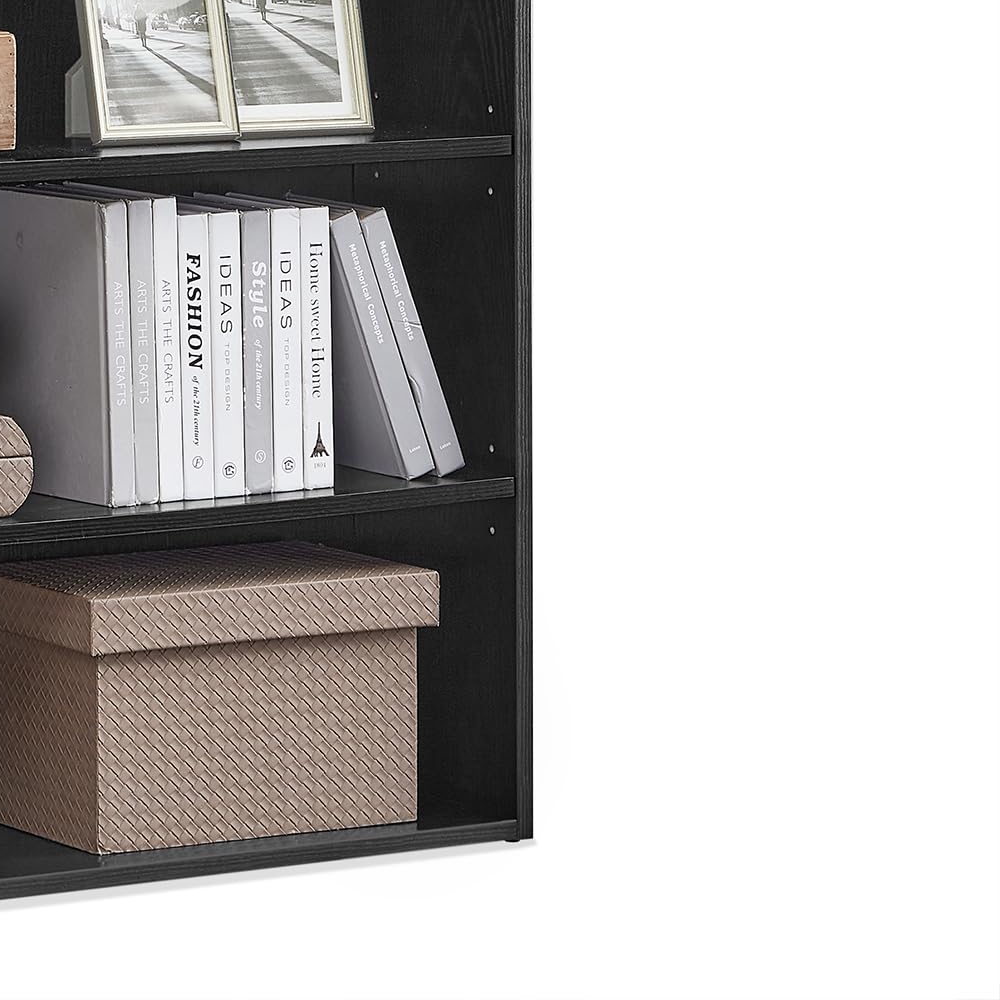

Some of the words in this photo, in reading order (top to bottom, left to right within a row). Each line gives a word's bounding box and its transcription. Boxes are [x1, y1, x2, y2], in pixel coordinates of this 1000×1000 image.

[280, 251, 293, 329] IDEAS
[310, 243, 324, 294] Home
[348, 243, 372, 301] Metaphorical
[368, 303, 384, 344] Concepts
[380, 240, 403, 298] Metaphorical
[398, 300, 415, 341] Concepts
[113, 281, 124, 315] ARTS
[137, 279, 148, 313] ARTS
[162, 279, 172, 313] ARTS
[186, 253, 203, 370] FASHION
[219, 255, 233, 334] IDEAS
[248, 261, 268, 328] Style
[310, 299, 322, 341] sweet
[115, 321, 125, 349] THE
[138, 319, 148, 347] THE
[163, 319, 173, 346] THE
[254, 339, 263, 349] of
[115, 355, 127, 407] CRAFTS
[138, 353, 149, 404] CRAFTS
[163, 353, 174, 404] CRAFTS
[192, 375, 200, 385] of
[311, 347, 325, 398] Home
[192, 418, 200, 447] century
